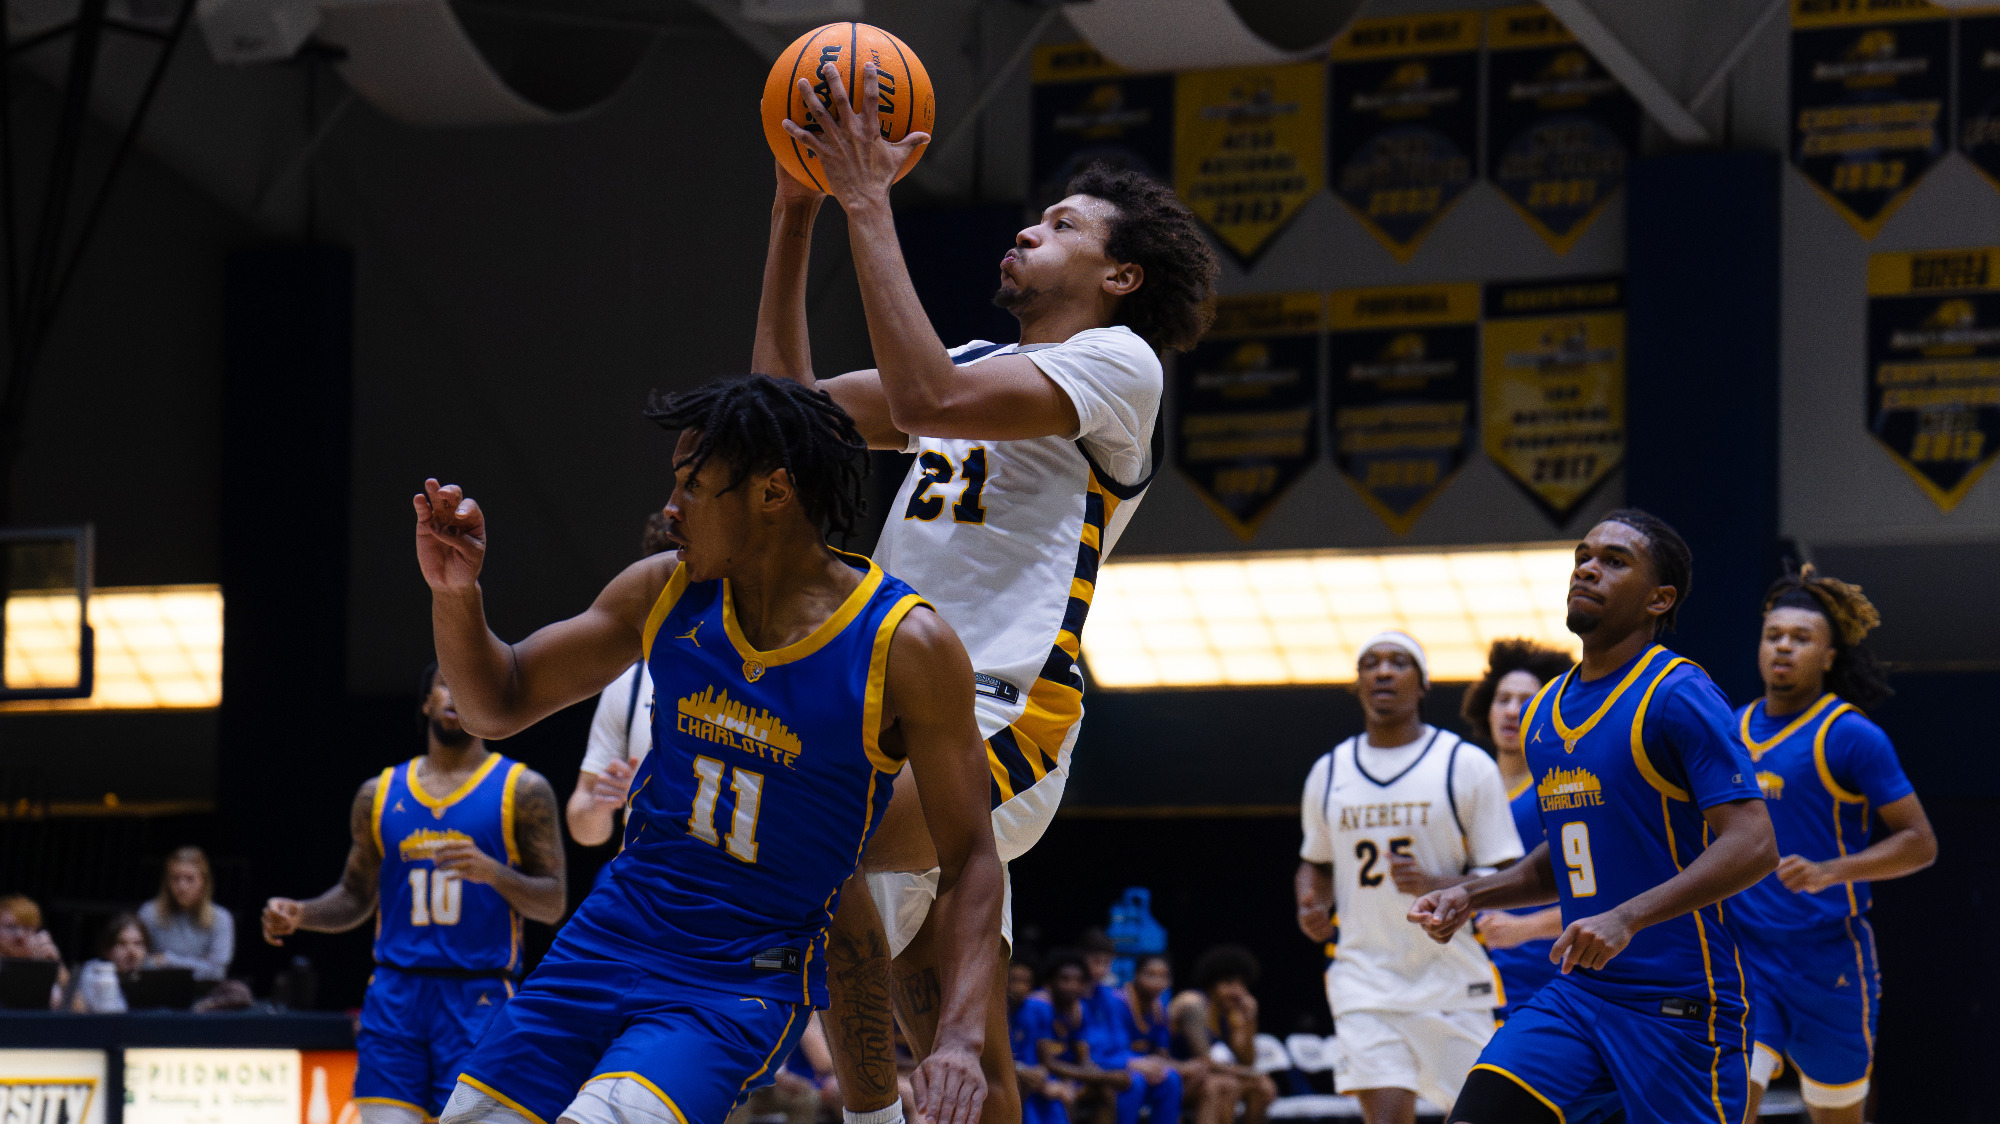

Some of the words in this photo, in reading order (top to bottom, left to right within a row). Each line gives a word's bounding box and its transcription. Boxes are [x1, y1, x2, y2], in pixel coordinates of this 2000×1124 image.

[904, 446, 988, 526] 21
[677, 712, 800, 770] CHARLOTTE
[704, 713, 769, 742] JWU
[686, 754, 764, 863] 11
[1339, 802, 1432, 832] AVERETT
[1540, 791, 1605, 812] CHARLOTTE
[1561, 821, 1597, 898] 9
[408, 868, 462, 926] 10
[149, 1063, 288, 1086] PIEDMONT
